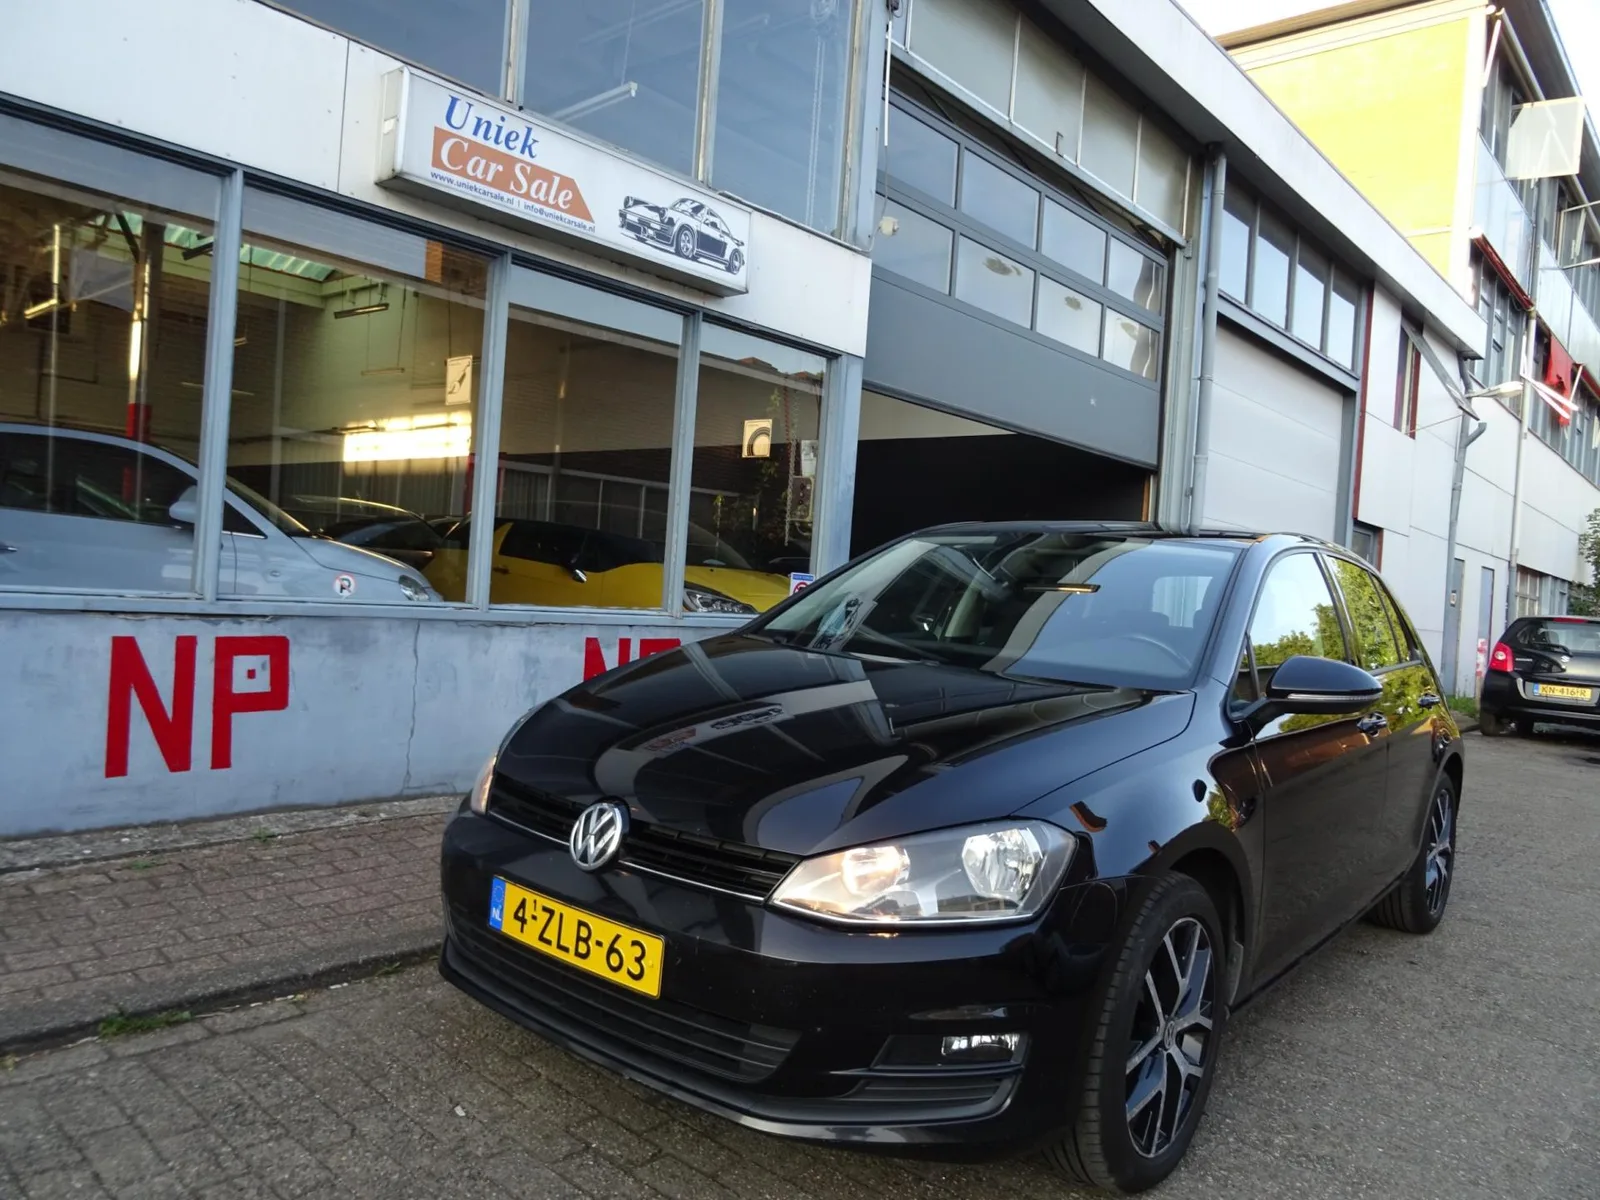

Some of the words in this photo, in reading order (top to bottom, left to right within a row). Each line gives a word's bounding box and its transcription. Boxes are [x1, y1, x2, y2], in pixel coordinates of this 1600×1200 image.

[445, 94, 540, 159] Uniek
[430, 171, 515, 206] www.uniekcarsale.nl
[523, 202, 596, 234] info@uniekcarsale.nl
[440, 137, 504, 183] Car
[509, 162, 574, 210] Sale
[105, 635, 289, 778] NP
[513, 897, 647, 981] 4-ZLB-63
